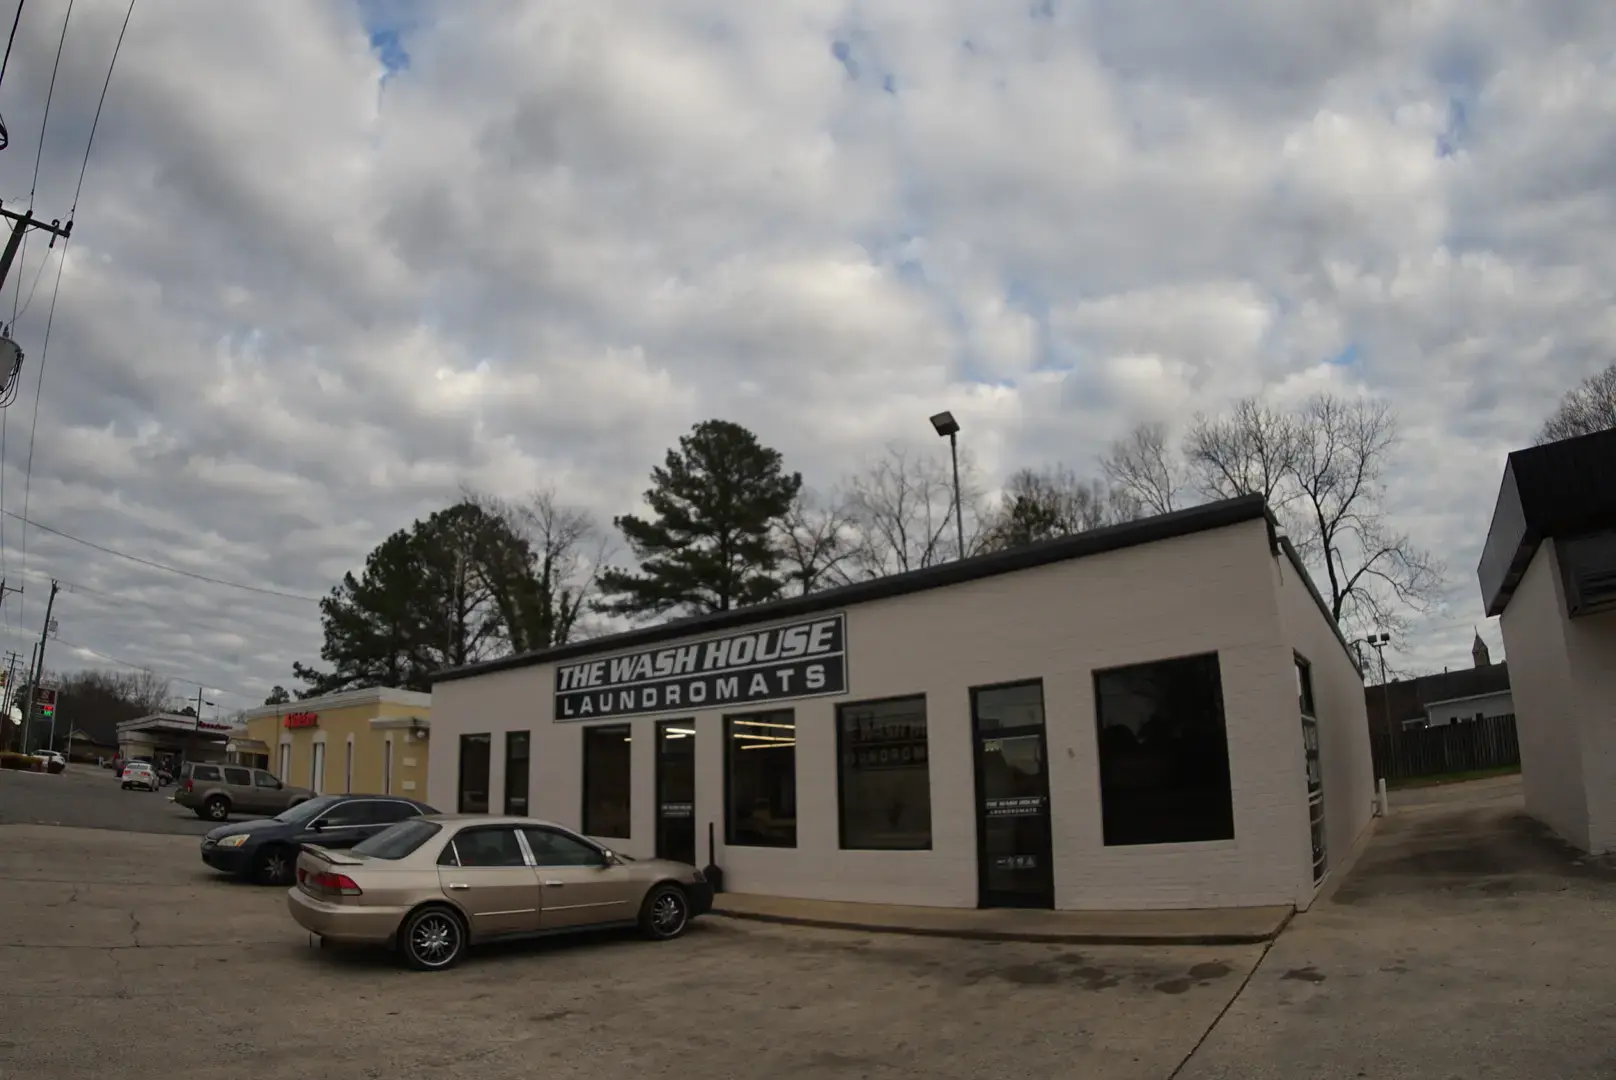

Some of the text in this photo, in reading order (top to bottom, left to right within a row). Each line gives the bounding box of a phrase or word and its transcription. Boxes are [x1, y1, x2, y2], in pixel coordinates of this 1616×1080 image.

[559, 620, 836, 690] THE WASH HOUSE
[563, 663, 826, 716] LAUNDROMATS
